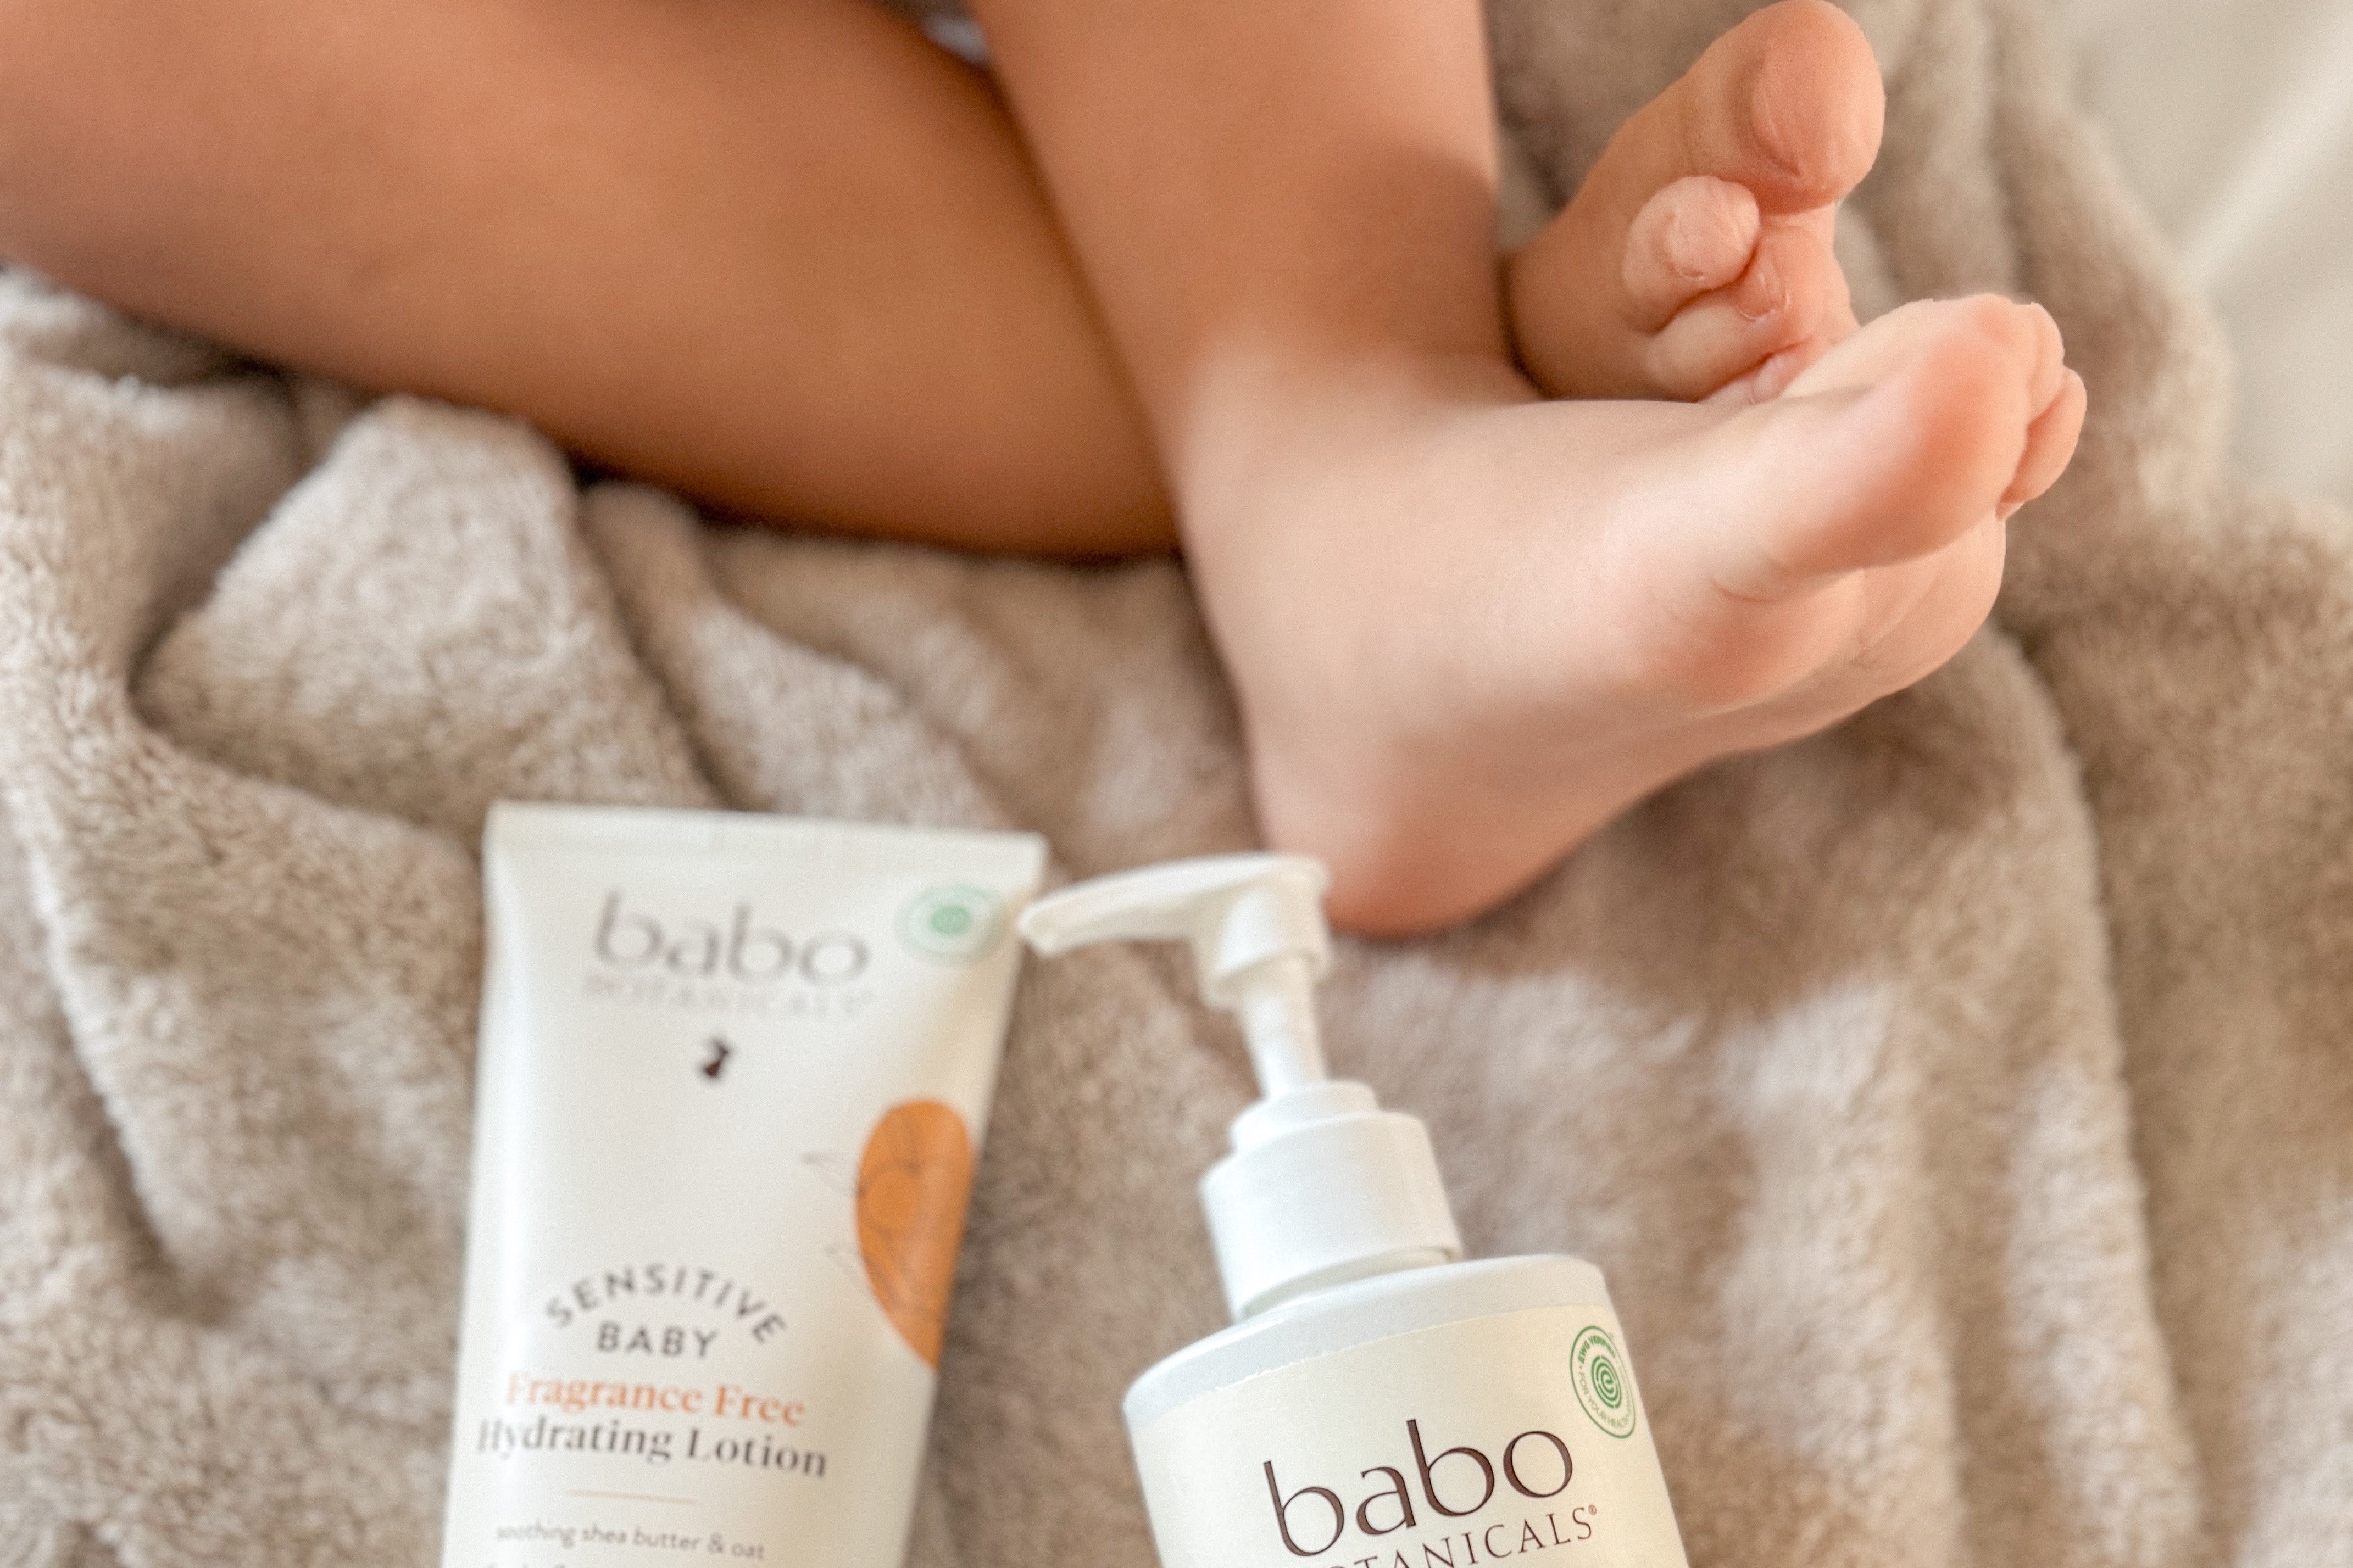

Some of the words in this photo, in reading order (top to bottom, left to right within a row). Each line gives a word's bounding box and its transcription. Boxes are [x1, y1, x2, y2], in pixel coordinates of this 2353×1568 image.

[593, 888, 870, 985] babo
[545, 1262, 787, 1346] SENSITIVE
[597, 1321, 717, 1359] BABY
[507, 1372, 703, 1414] Fragrance
[714, 1385, 805, 1427] Free
[478, 1415, 674, 1465] Hydrating
[687, 1427, 828, 1477] Lotion
[1263, 1419, 1573, 1556] babo
[582, 1522, 627, 1544] shea
[632, 1526, 700, 1552] butter
[707, 1532, 724, 1554] &
[730, 1542, 765, 1560] oat
